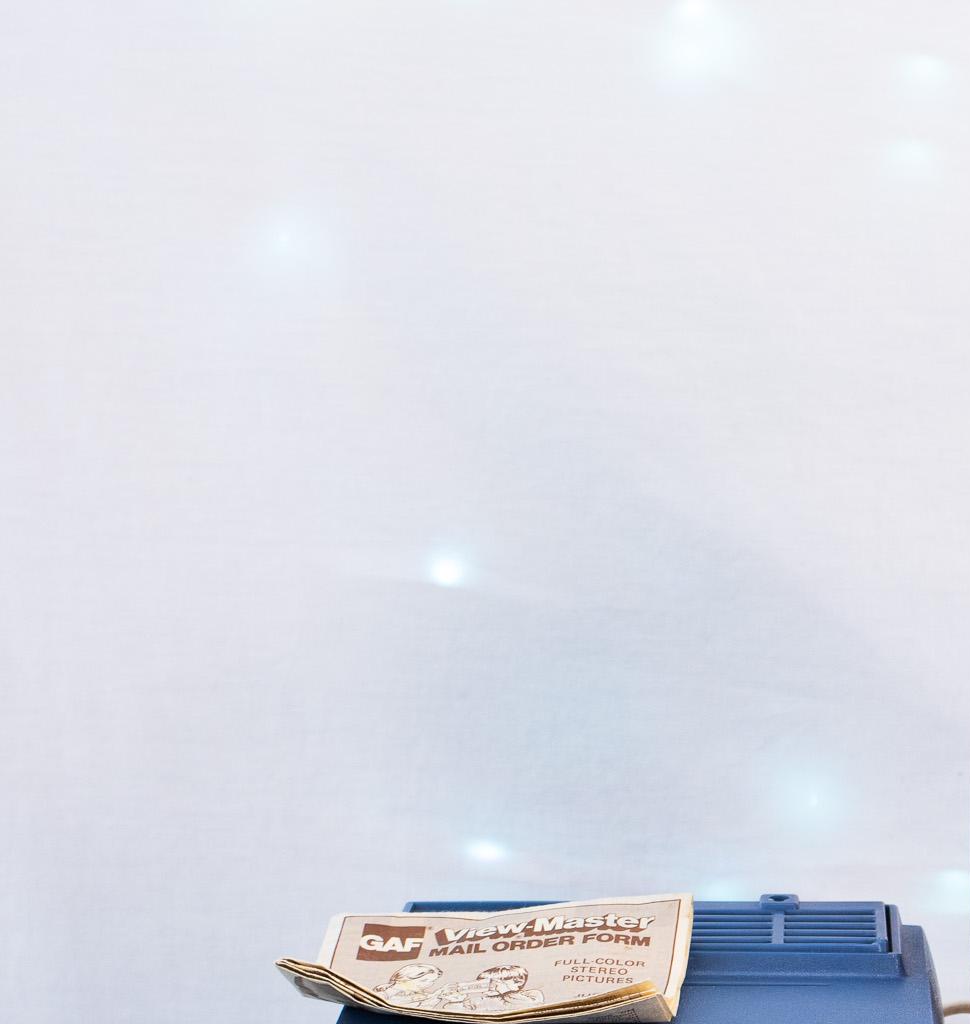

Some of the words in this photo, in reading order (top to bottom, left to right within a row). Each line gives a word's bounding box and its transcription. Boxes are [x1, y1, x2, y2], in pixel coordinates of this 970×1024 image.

[360, 934, 425, 953] GAF
[438, 913, 656, 945] View-Master
[429, 941, 487, 957] MAIL
[491, 935, 576, 953] ORDER
[582, 932, 651, 947] FORM
[554, 957, 647, 968] FULL-COLOR
[570, 966, 628, 975] STEREO
[562, 975, 633, 984] PICTURES
